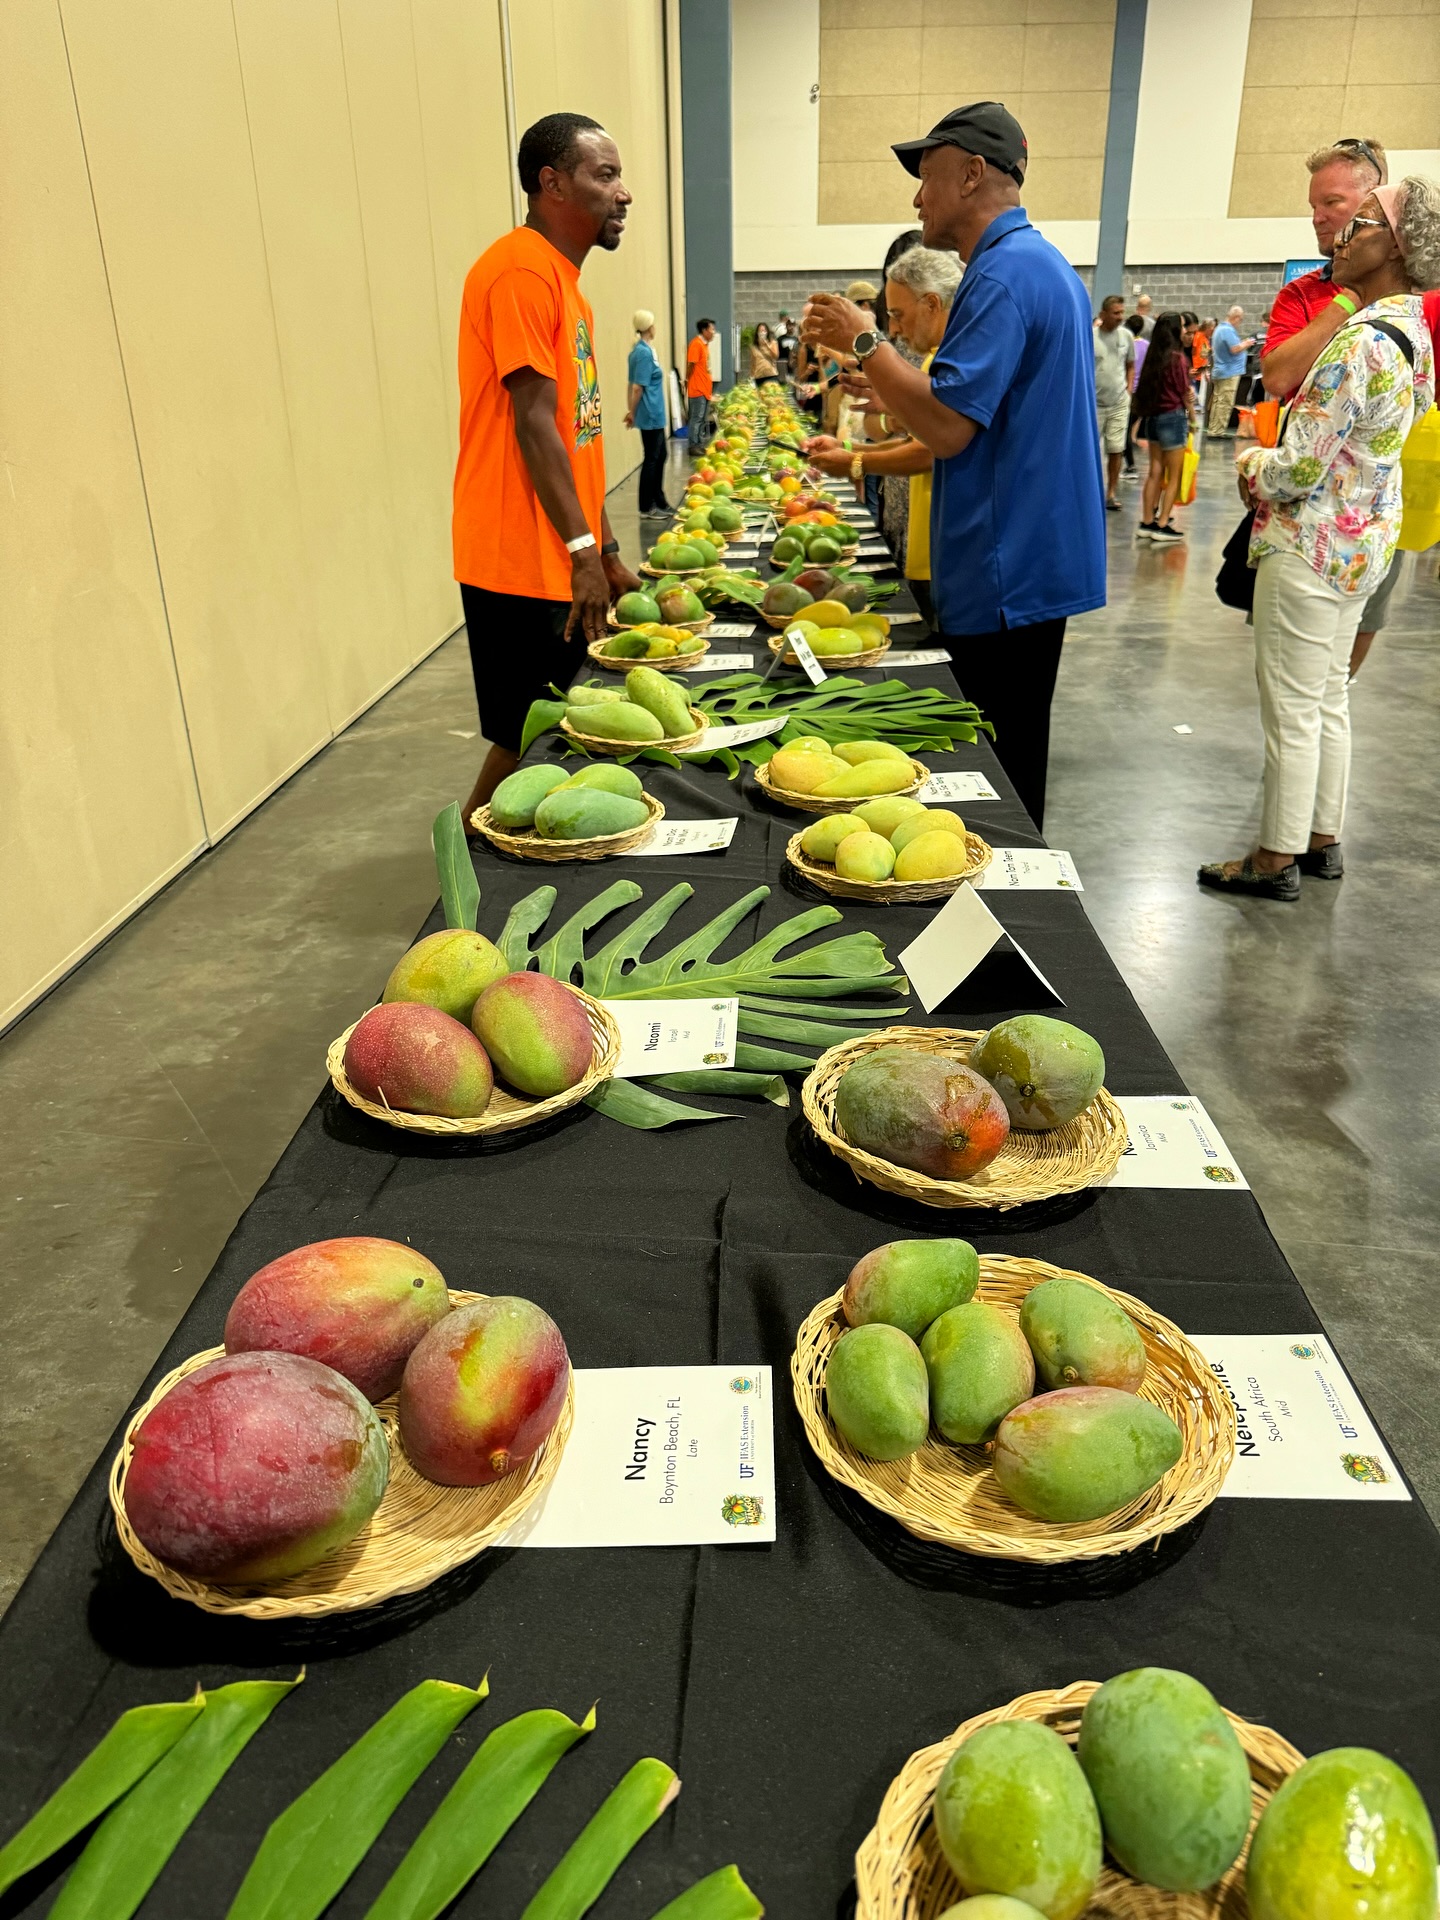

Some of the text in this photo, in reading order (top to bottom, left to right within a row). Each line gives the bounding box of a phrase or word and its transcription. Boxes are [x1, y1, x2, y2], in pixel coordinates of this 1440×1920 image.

[644, 1022, 661, 1051] Naomi
[668, 1029, 678, 1042] Israel
[1138, 1124, 1158, 1151] Jamaica
[1156, 1132, 1168, 1143] Mid
[1204, 1148, 1218, 1158] UF
[1314, 1370, 1335, 1404] Extension
[1247, 1377, 1283, 1442] South Africa
[1275, 1400, 1292, 1418] Mid
[1330, 1404, 1345, 1421] IFAS
[740, 1405, 755, 1479] UF IFAS Extension
[1339, 1423, 1359, 1439] UF
[624, 1417, 657, 1481] Nancy
[659, 1396, 682, 1504] Boynton Beach, FL
[687, 1439, 698, 1458] Late
